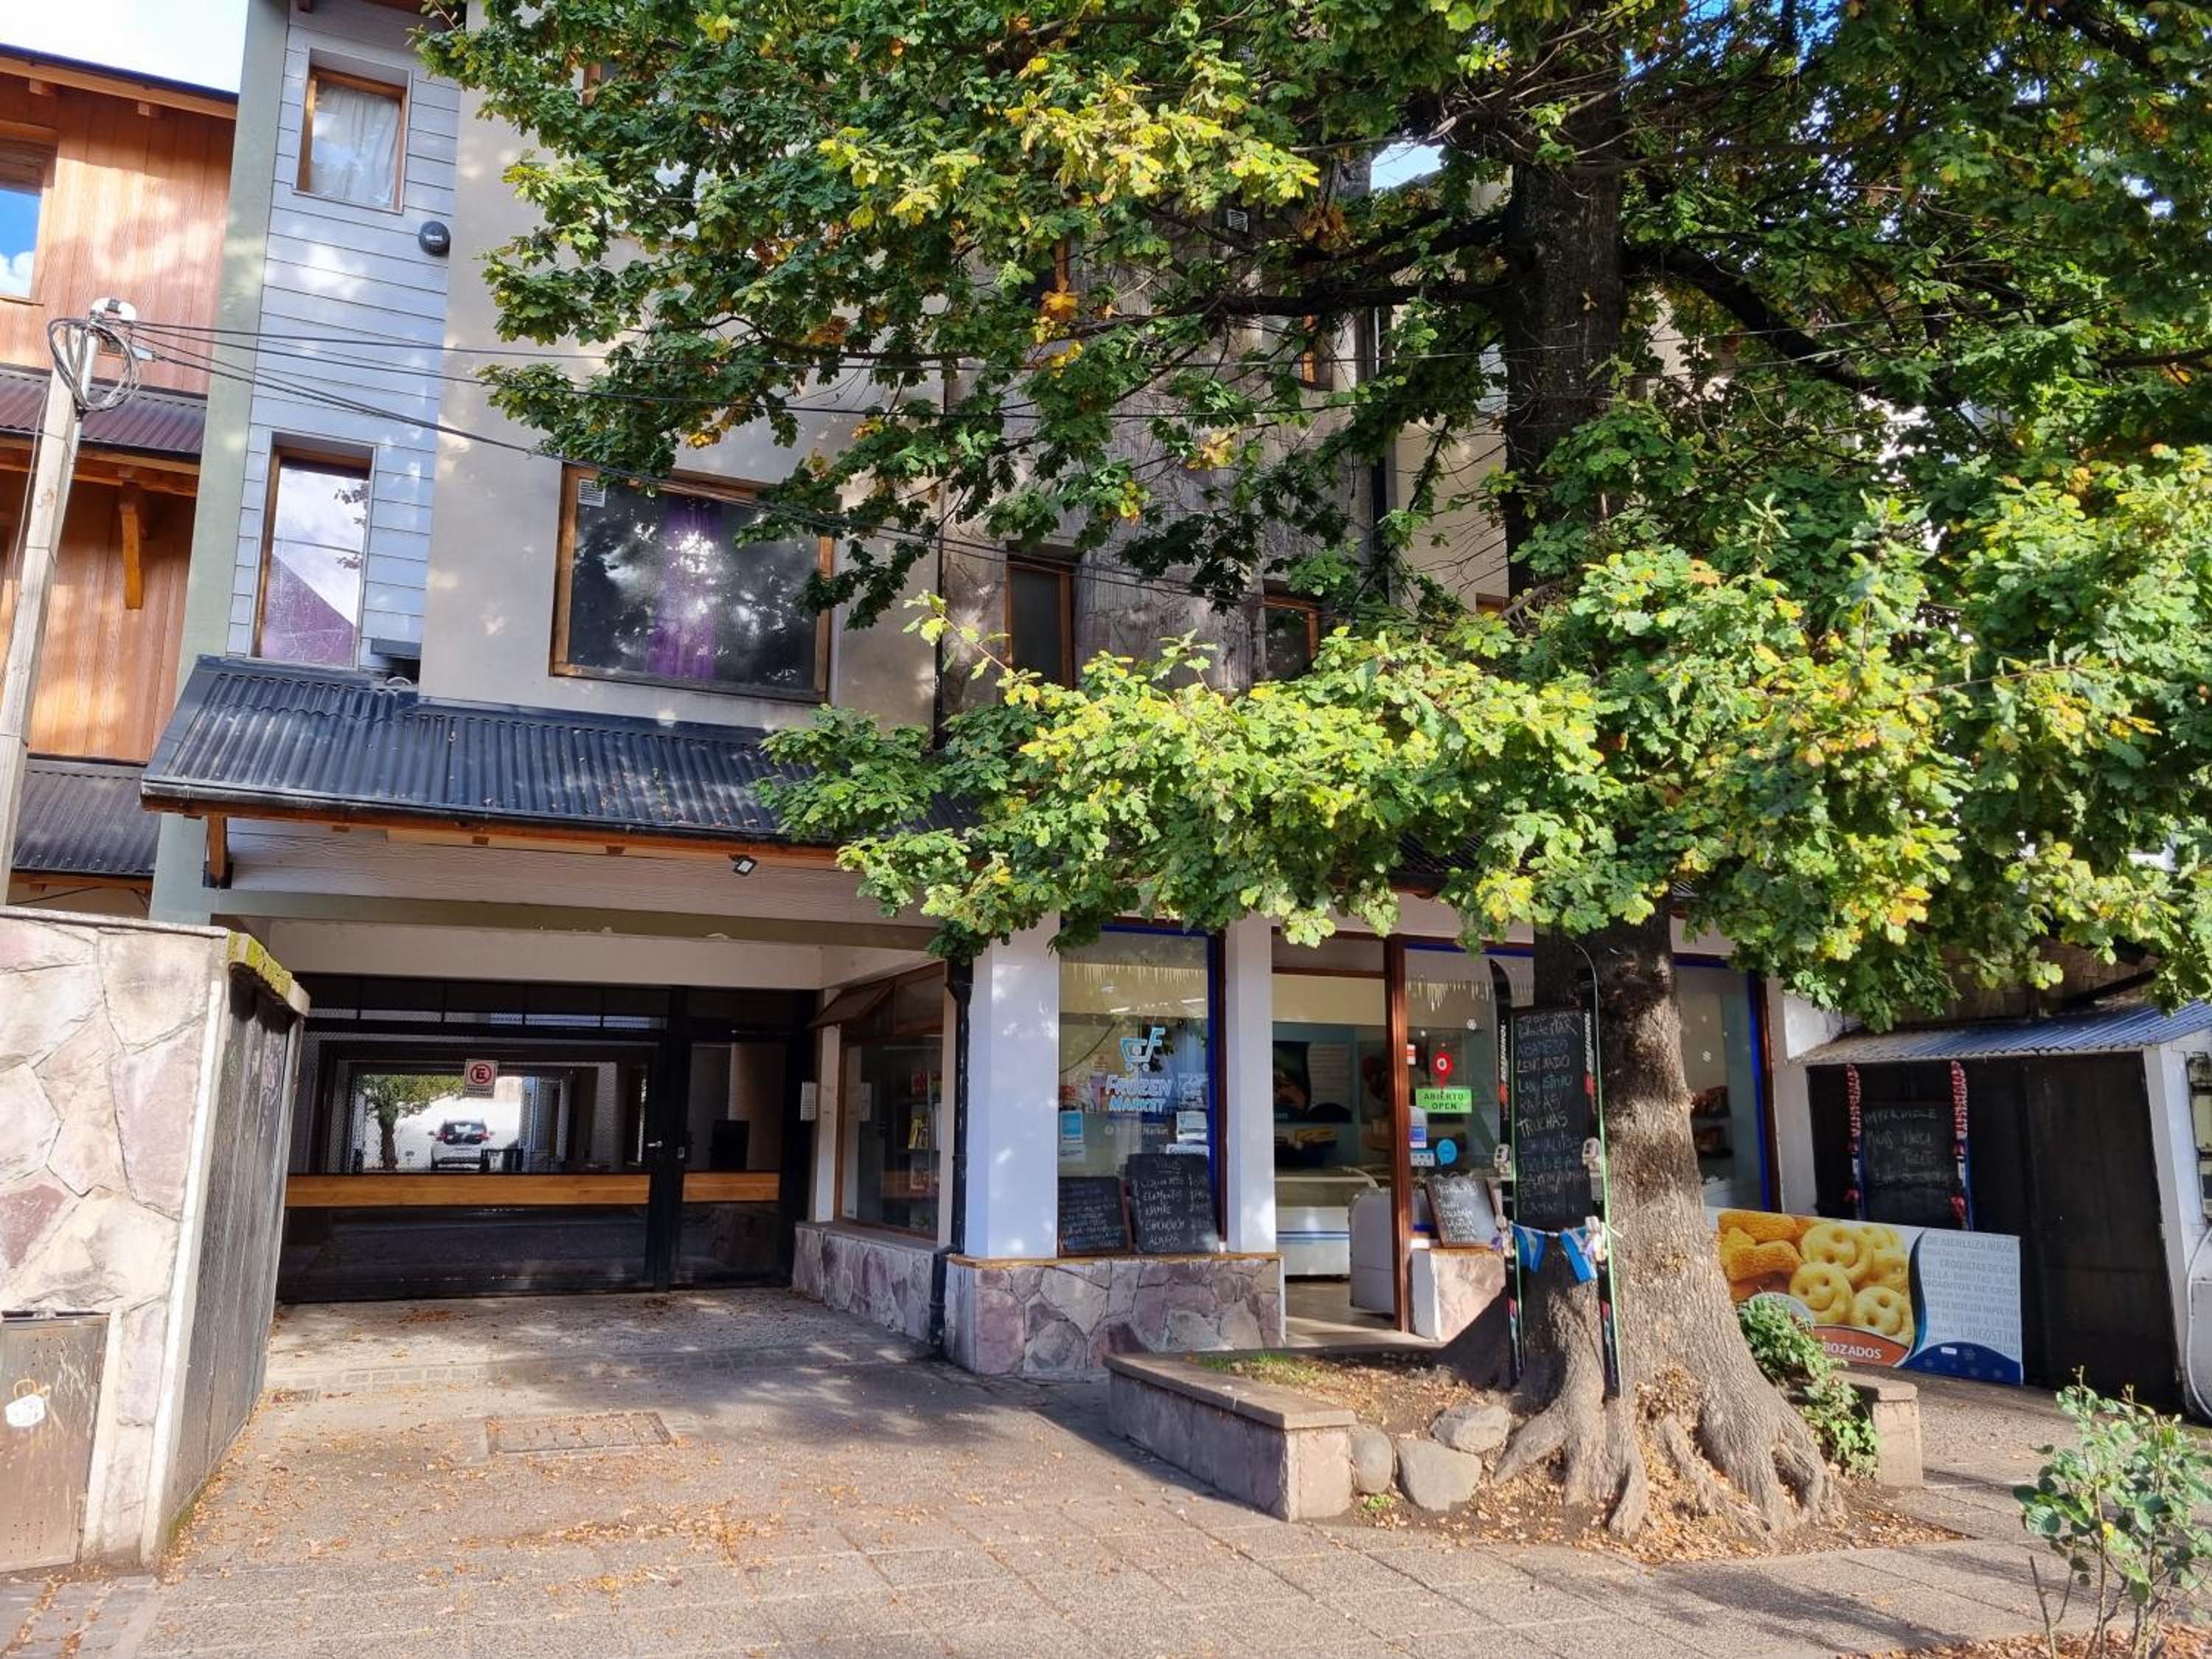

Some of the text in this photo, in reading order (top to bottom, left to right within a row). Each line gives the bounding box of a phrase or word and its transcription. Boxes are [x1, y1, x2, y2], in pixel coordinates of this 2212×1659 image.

[1105, 1074, 1172, 1096] FROZEN
[1108, 1096, 1166, 1114] MARKET
[1424, 1092, 1464, 1102] ABIERTO
